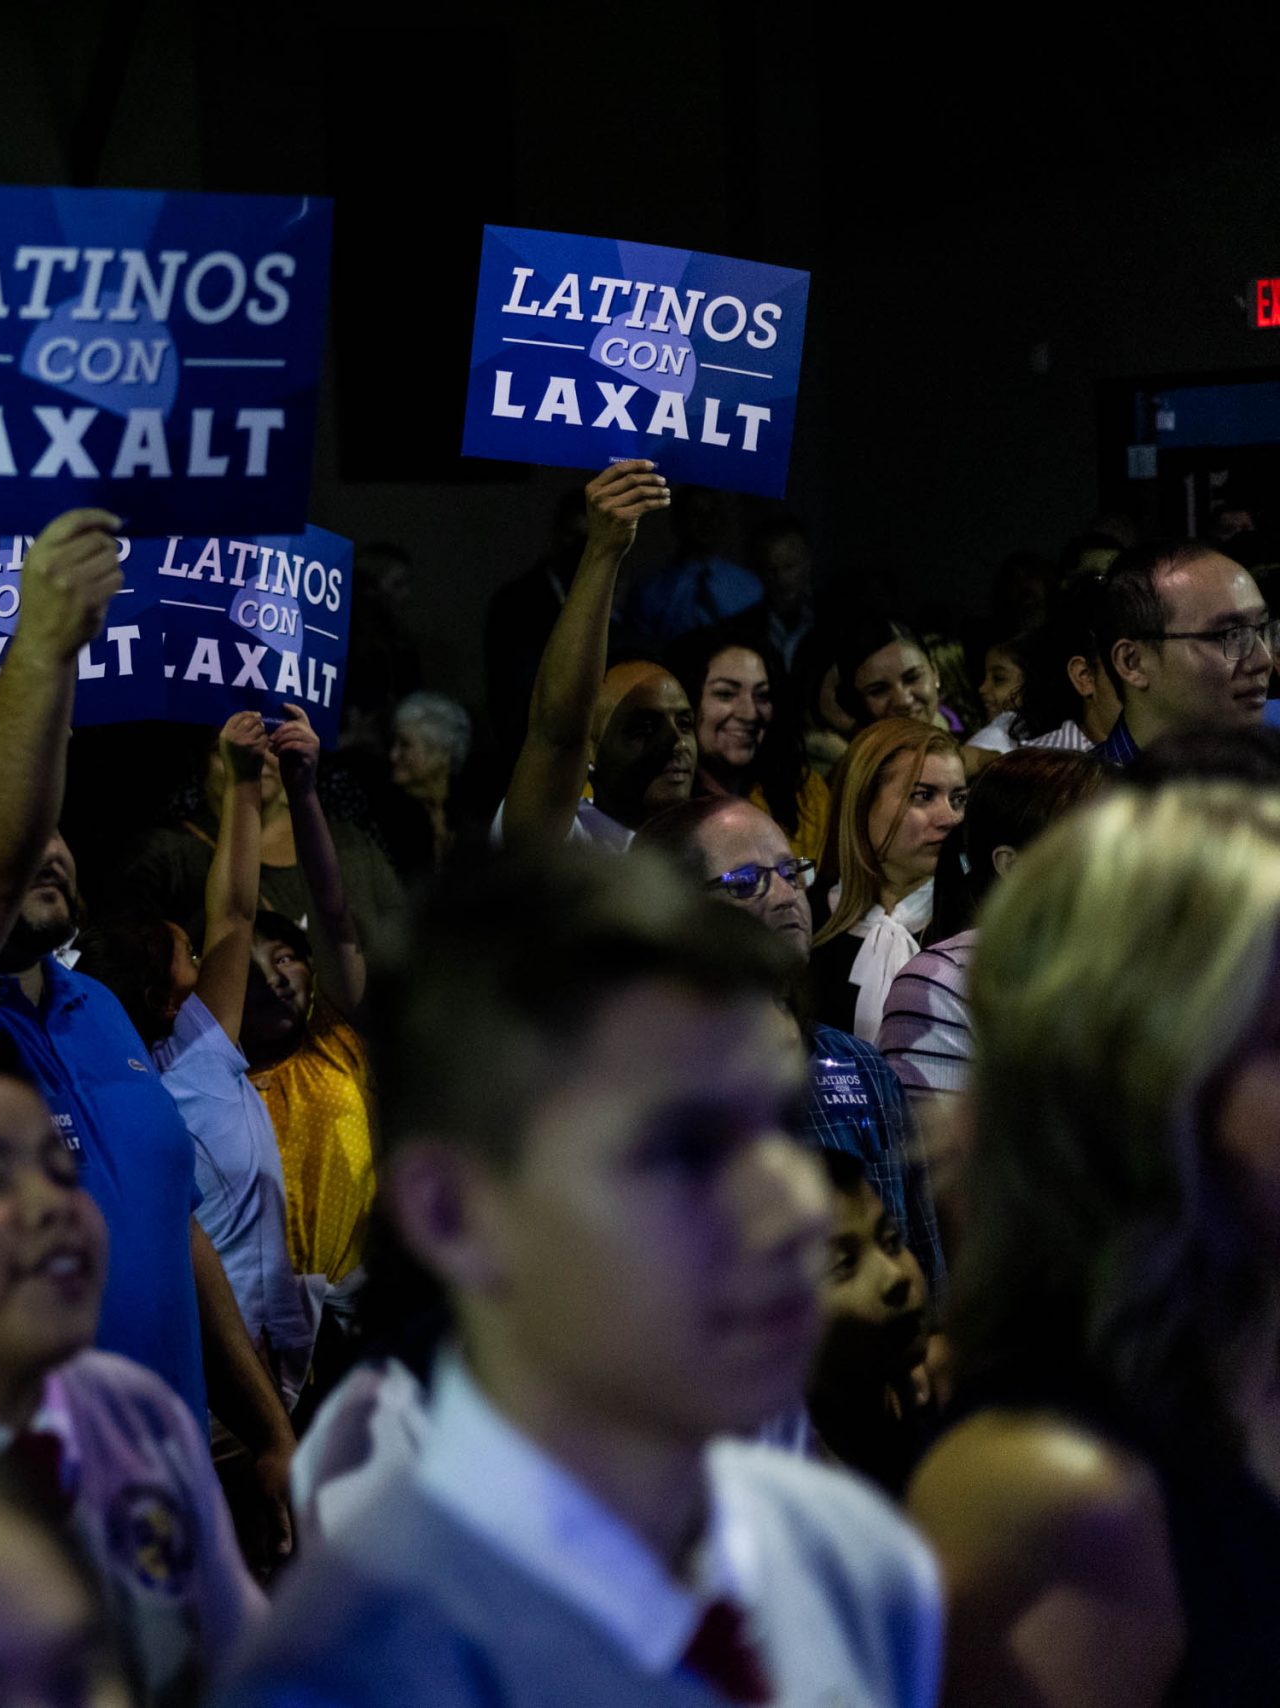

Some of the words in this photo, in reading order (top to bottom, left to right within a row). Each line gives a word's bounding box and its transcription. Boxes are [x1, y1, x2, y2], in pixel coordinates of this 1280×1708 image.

[501, 266, 783, 350] LATINOS
[38, 336, 172, 386] CON
[600, 337, 691, 377] CON
[491, 370, 773, 453] LAXALT
[158, 535, 343, 612] LATINOS
[237, 599, 299, 637] CON
[162, 632, 339, 709] AXALT
[816, 1075, 861, 1086] LATINOS
[824, 1094, 869, 1105] LAXALT
